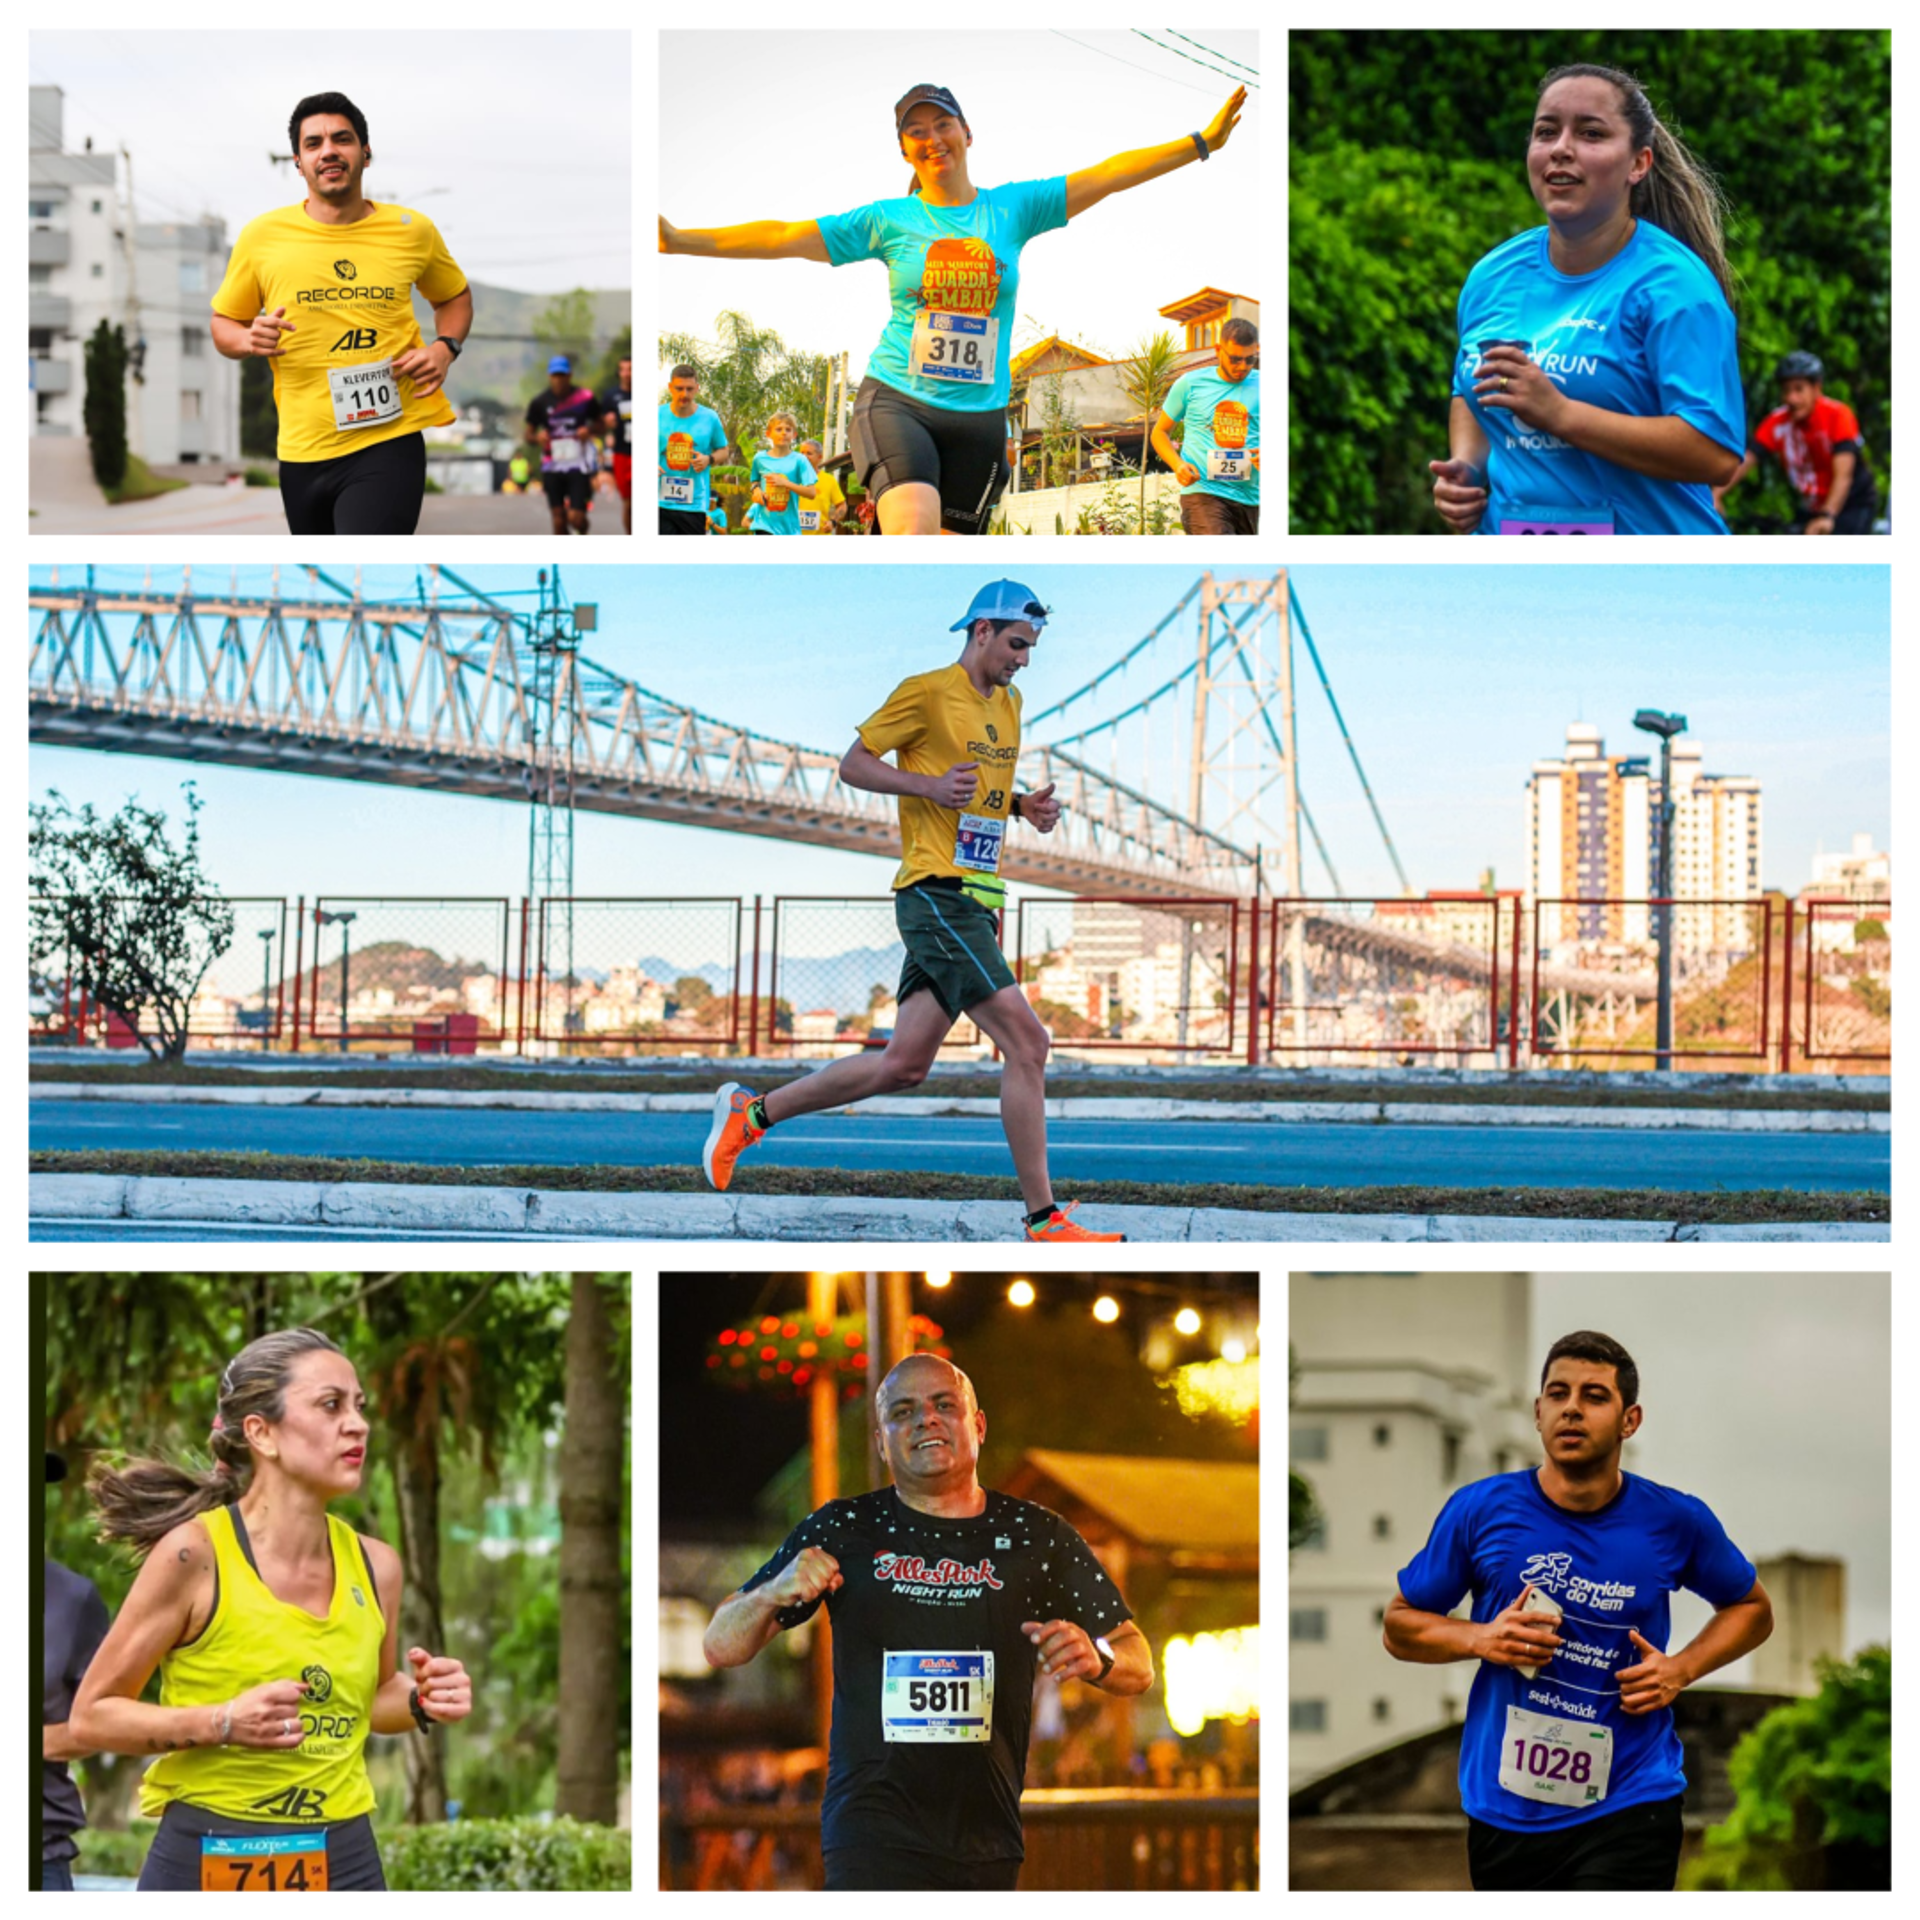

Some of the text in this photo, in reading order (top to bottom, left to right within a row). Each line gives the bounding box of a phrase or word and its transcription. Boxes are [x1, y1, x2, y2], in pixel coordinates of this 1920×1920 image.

[921, 269, 988, 289] GUARDA
[296, 286, 395, 304] RECORDE
[922, 285, 999, 309] EMBAÚ
[329, 328, 378, 352] AB
[928, 336, 978, 365] 318
[1545, 354, 1598, 375] RUN
[350, 385, 390, 409] 110
[1220, 461, 1236, 473] 25
[892, 1583, 983, 1599] NIGHT RUN
[1569, 1576, 1636, 1597] corridas
[1566, 1588, 1625, 1611] do bem
[1565, 1651, 1591, 1665] você
[909, 1681, 969, 1712] 5811
[1514, 1739, 1592, 1784] 1028
[250, 1785, 328, 1818] AB
[229, 1859, 310, 1891] 714
